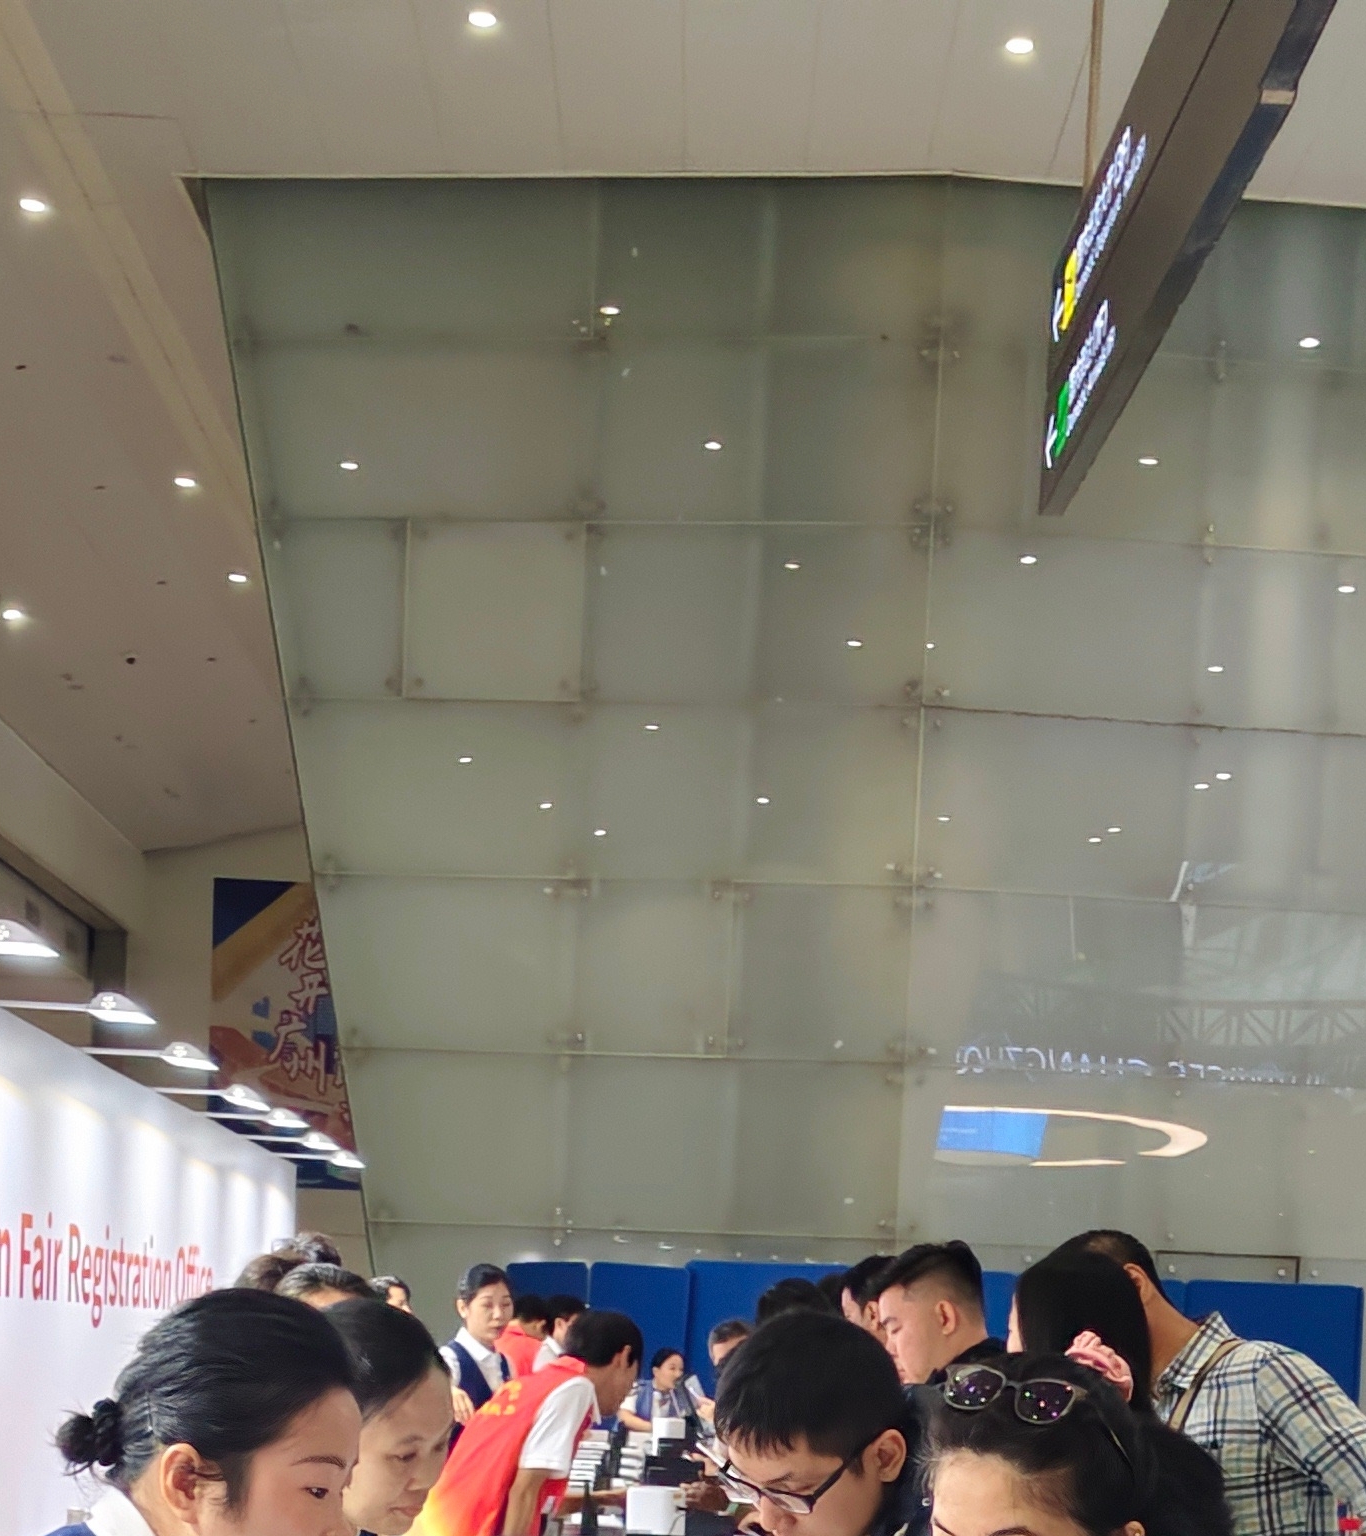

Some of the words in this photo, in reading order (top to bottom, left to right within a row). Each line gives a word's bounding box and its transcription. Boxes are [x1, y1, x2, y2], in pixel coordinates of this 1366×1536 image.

[18, 1212, 63, 1301] Fair
[67, 1223, 172, 1329] Registration
[175, 1245, 213, 1306] Office
